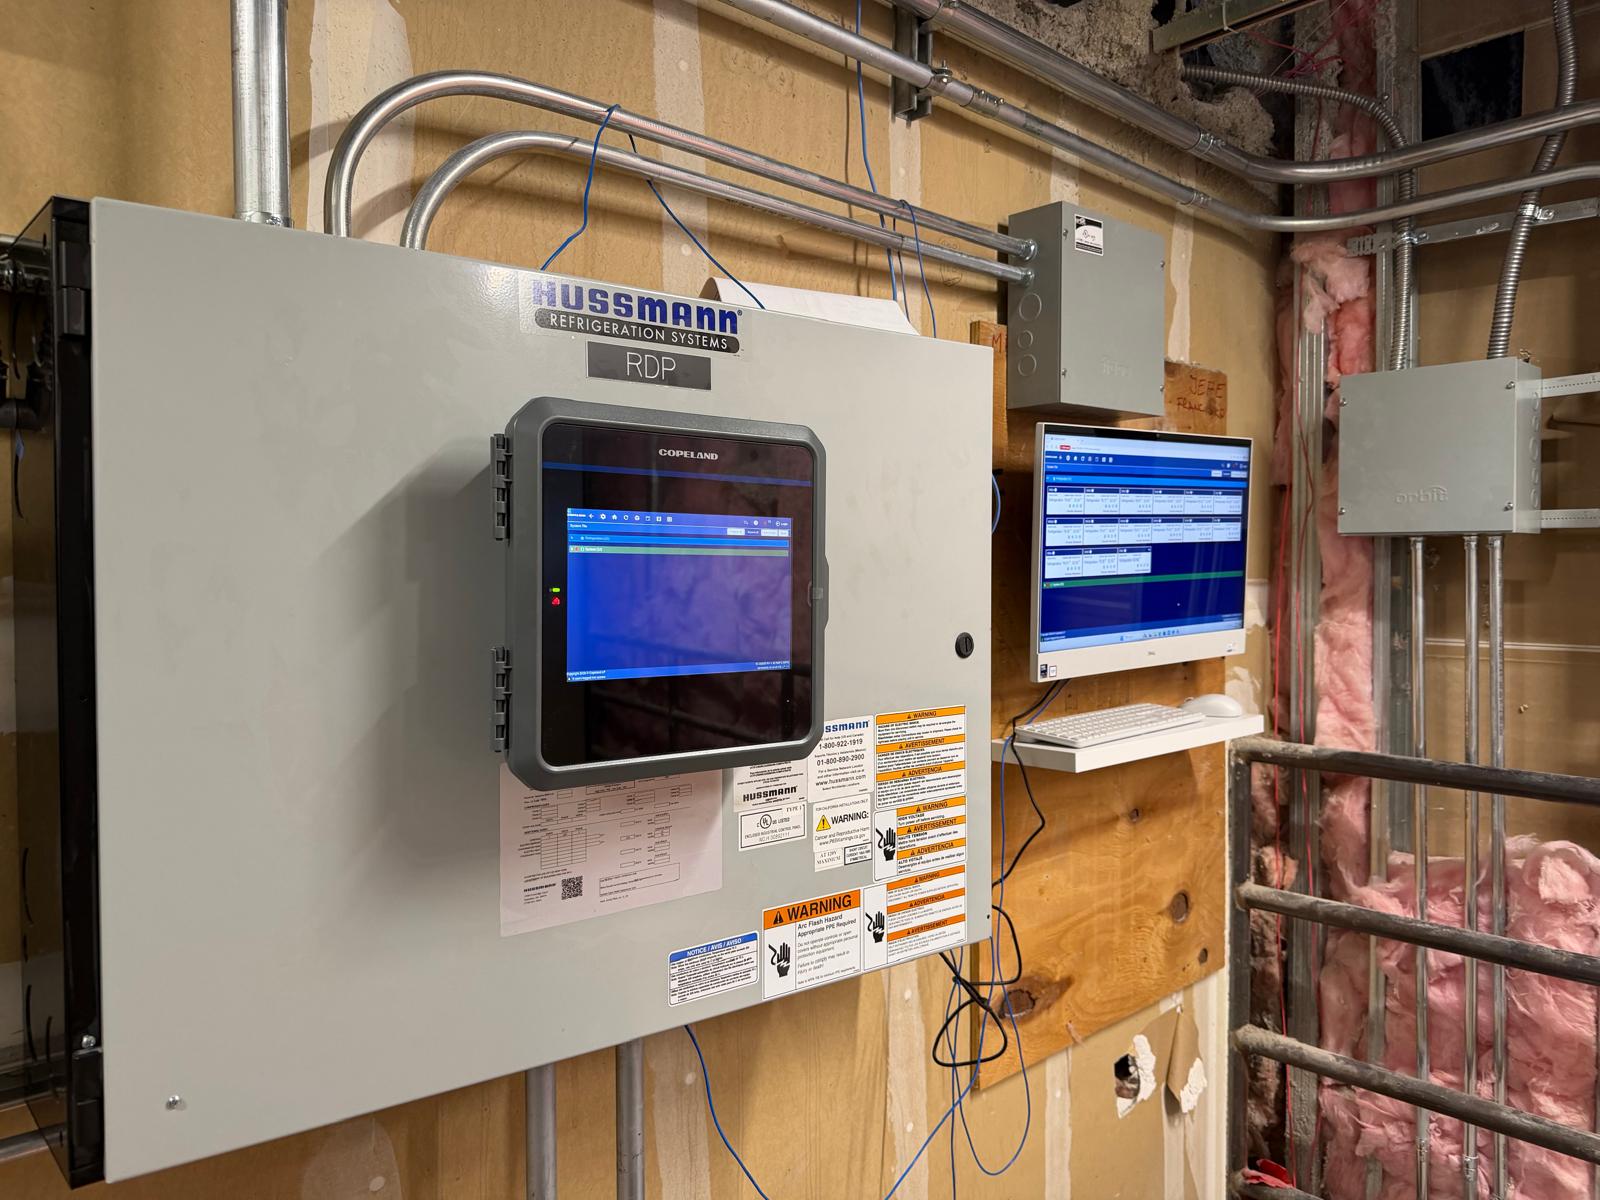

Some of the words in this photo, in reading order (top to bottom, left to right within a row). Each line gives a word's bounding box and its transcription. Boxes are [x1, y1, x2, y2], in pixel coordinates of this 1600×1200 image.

[550, 313, 665, 342] REFRIGERATION
[671, 329, 728, 350] SYSTEMS
[626, 352, 677, 380] RDP
[658, 447, 719, 461] COPELAND
[825, 720, 870, 733] SSMANN
[904, 738, 945, 748] AVERTISSEMENT
[908, 766, 942, 776] ADVERTENCIA
[743, 786, 797, 802] HUSSMANN
[923, 802, 948, 810] WARNING
[831, 811, 869, 824] WARNING:
[914, 819, 956, 831] AVERTISSEMENT
[917, 842, 954, 854] ADVERTENCIA
[918, 872, 940, 881] WARNING
[914, 894, 944, 906] ADVERTENCIA
[787, 894, 852, 920] WARNING
[809, 918, 823, 928] Flash
[824, 914, 843, 923] Hazard
[912, 920, 947, 933] AVERTISSEMENT
[798, 927, 824, 938] Appropriate
[836, 918, 856, 928] Required
[687, 947, 706, 956] NOTICE
[711, 943, 722, 951] AVIS
[726, 938, 742, 946] AVISO
